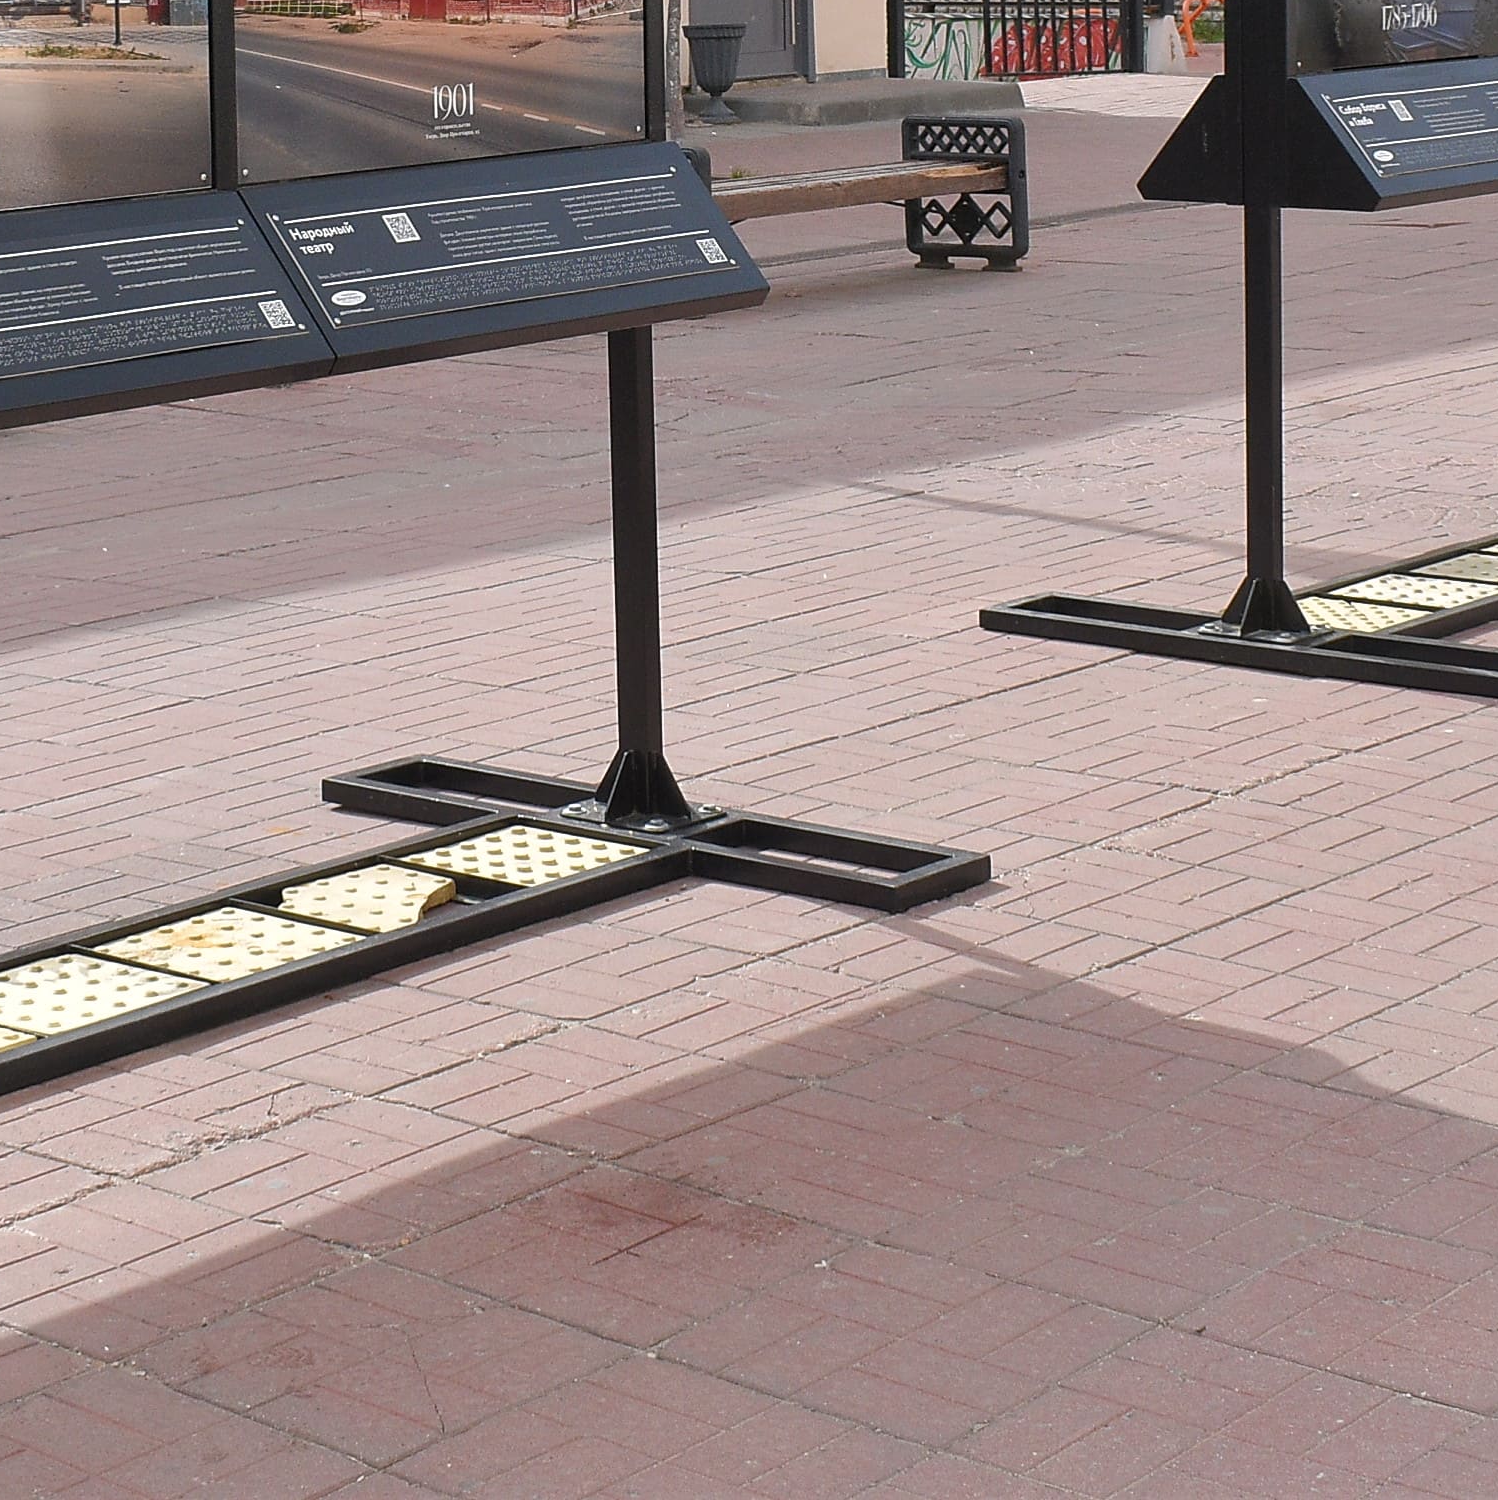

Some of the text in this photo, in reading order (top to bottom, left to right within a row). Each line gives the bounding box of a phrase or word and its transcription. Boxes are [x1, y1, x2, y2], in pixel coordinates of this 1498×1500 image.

[1382, 0, 1438, 31] 1785-1796
[432, 82, 474, 121] 1901
[288, 221, 355, 242] Народный
[299, 241, 335, 257] театр
